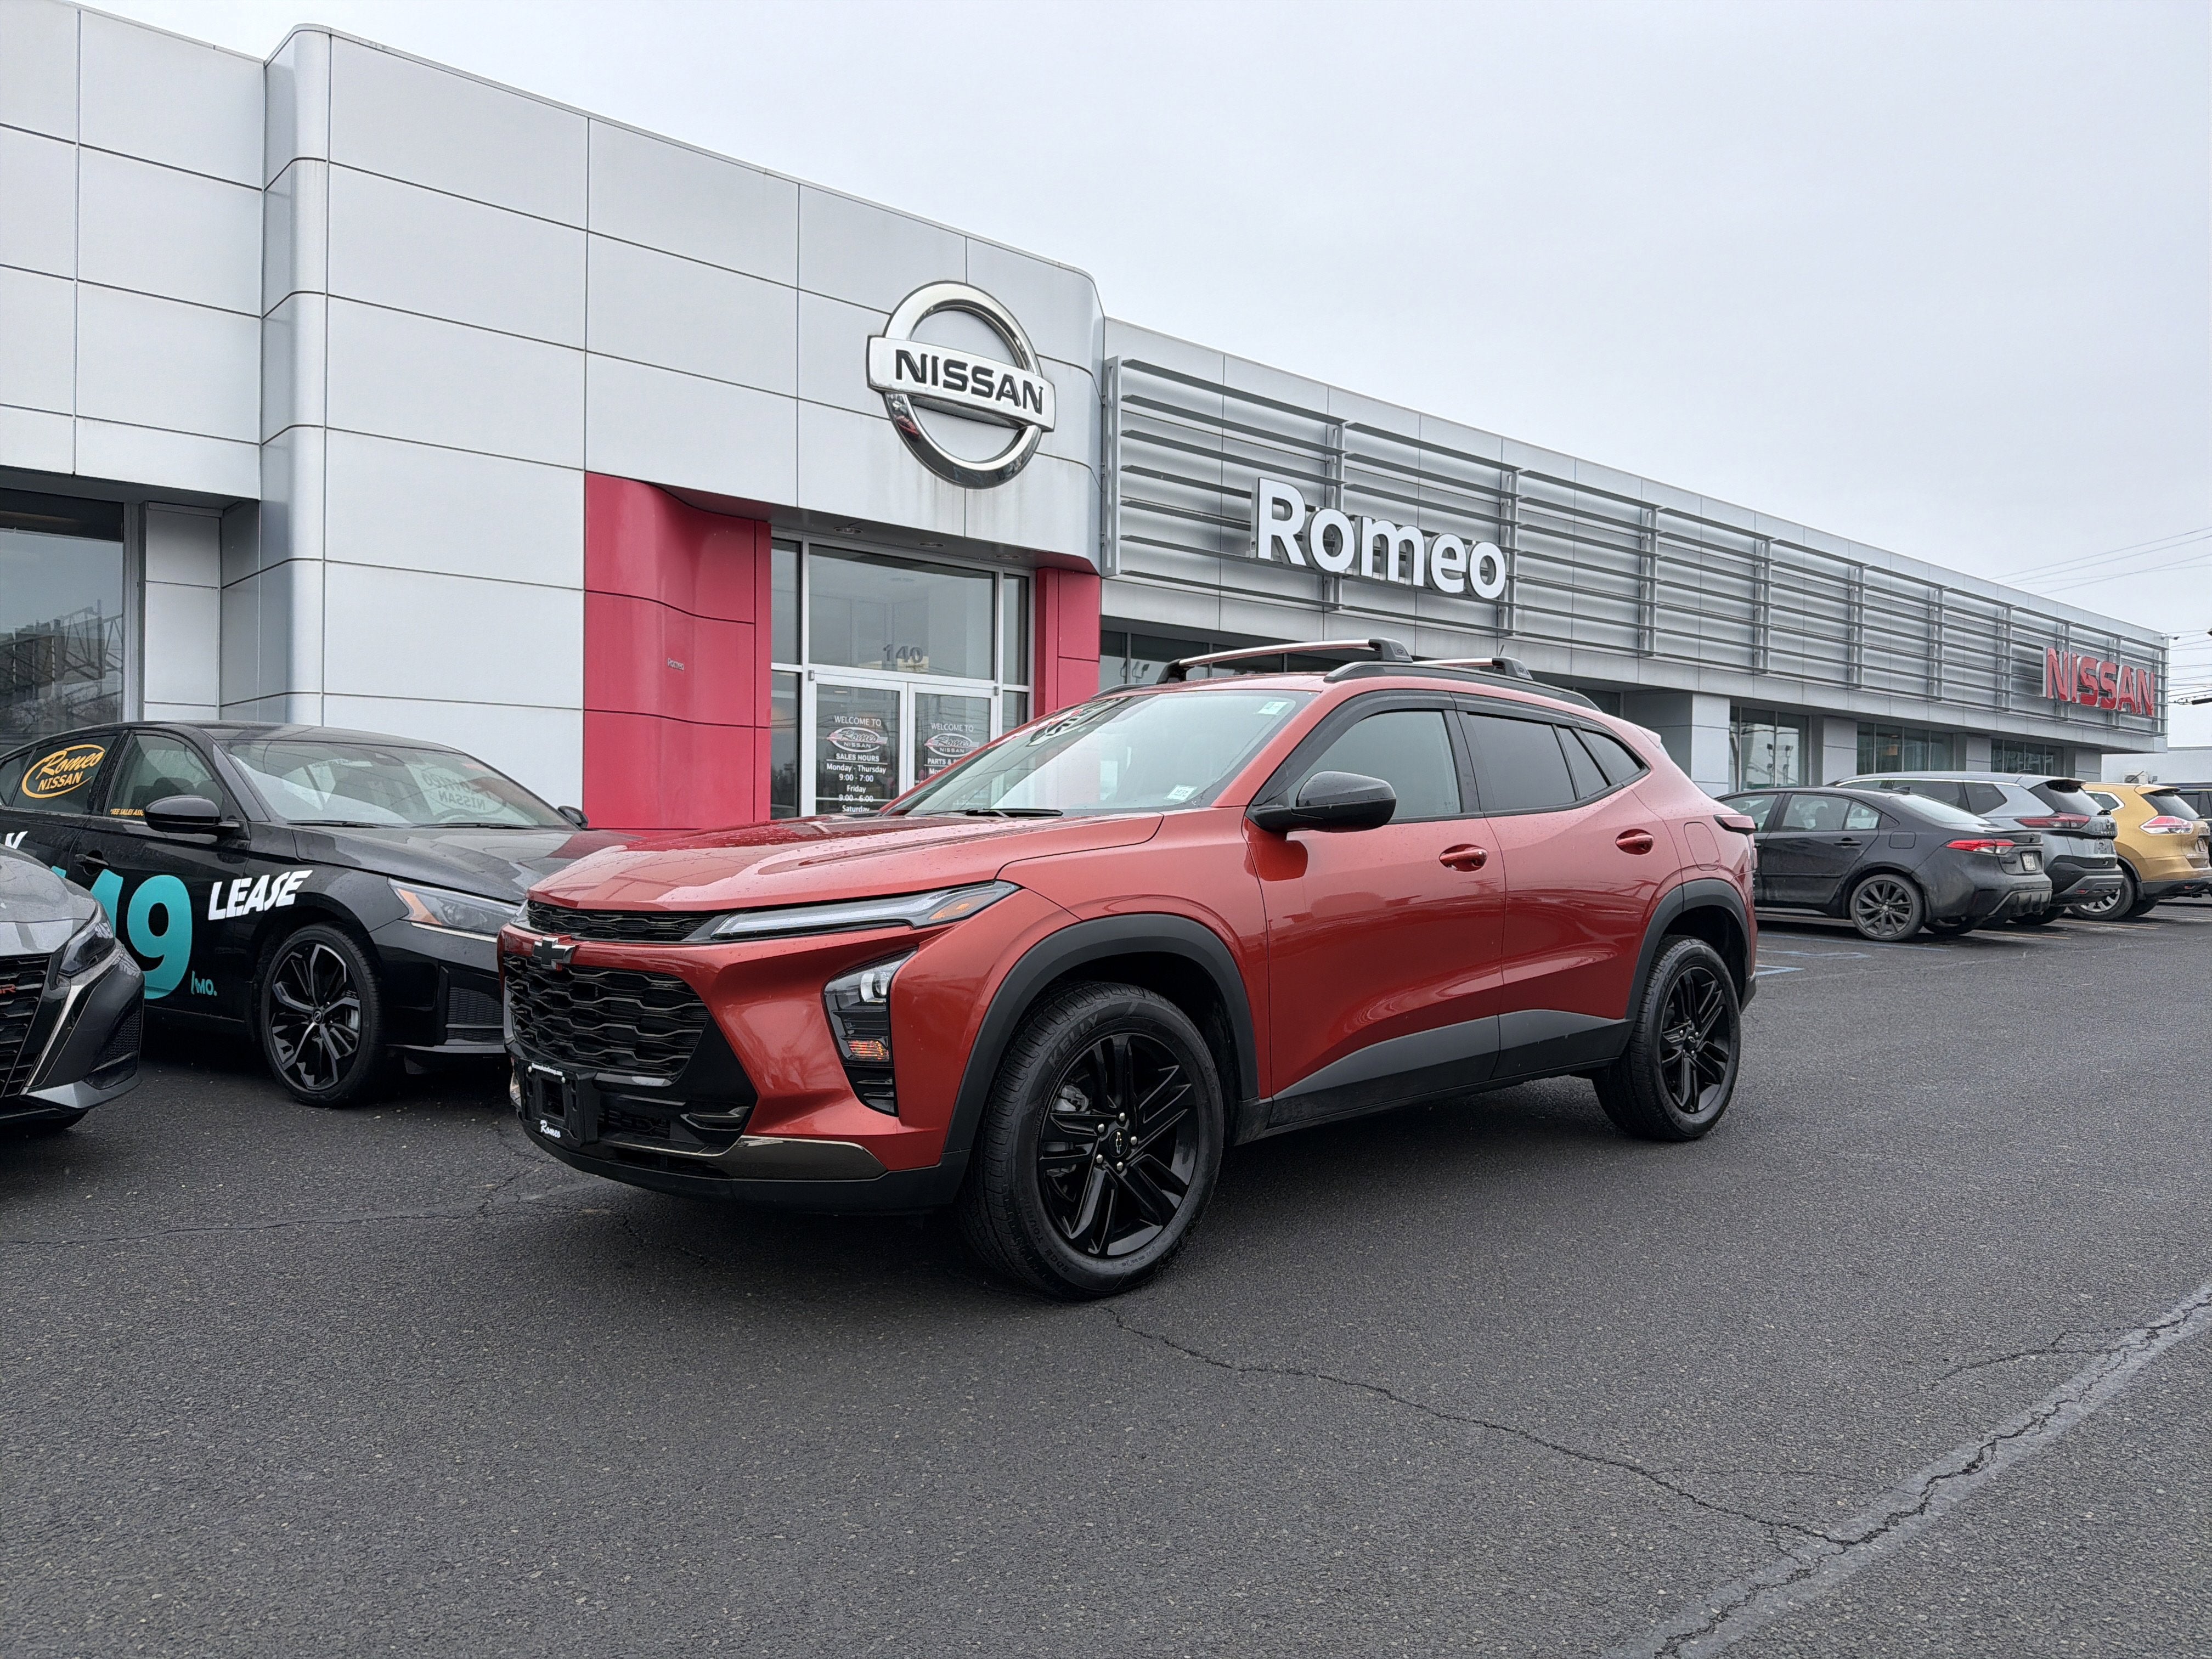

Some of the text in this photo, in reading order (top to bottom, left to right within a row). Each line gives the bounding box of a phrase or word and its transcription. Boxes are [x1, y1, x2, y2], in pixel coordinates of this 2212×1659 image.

[895, 349, 1043, 415] NISSAN
[1252, 477, 1506, 600] Romeo
[883, 644, 923, 663] 140
[2045, 647, 2155, 717] NISSAN
[834, 715, 882, 727] WELCOME TO
[931, 723, 963, 732] WELCOME
[840, 729, 878, 742] Romeo
[934, 735, 971, 747] Romeo
[35, 750, 104, 780] Romeo
[857, 754, 880, 763] HOURS
[826, 763, 852, 773] Monday
[857, 764, 887, 775] Thursday
[839, 773, 854, 781] 9:00
[859, 774, 874, 782] 7:00
[37, 771, 84, 792] NISSAN
[847, 785, 866, 794] Friday
[859, 794, 874, 803] 6:00
[208, 870, 313, 921] LEASE
[1047, 1013, 1098, 1069] KELLY
[540, 1119, 562, 1139] Romeo
[1045, 1246, 1070, 1274] EDGE
